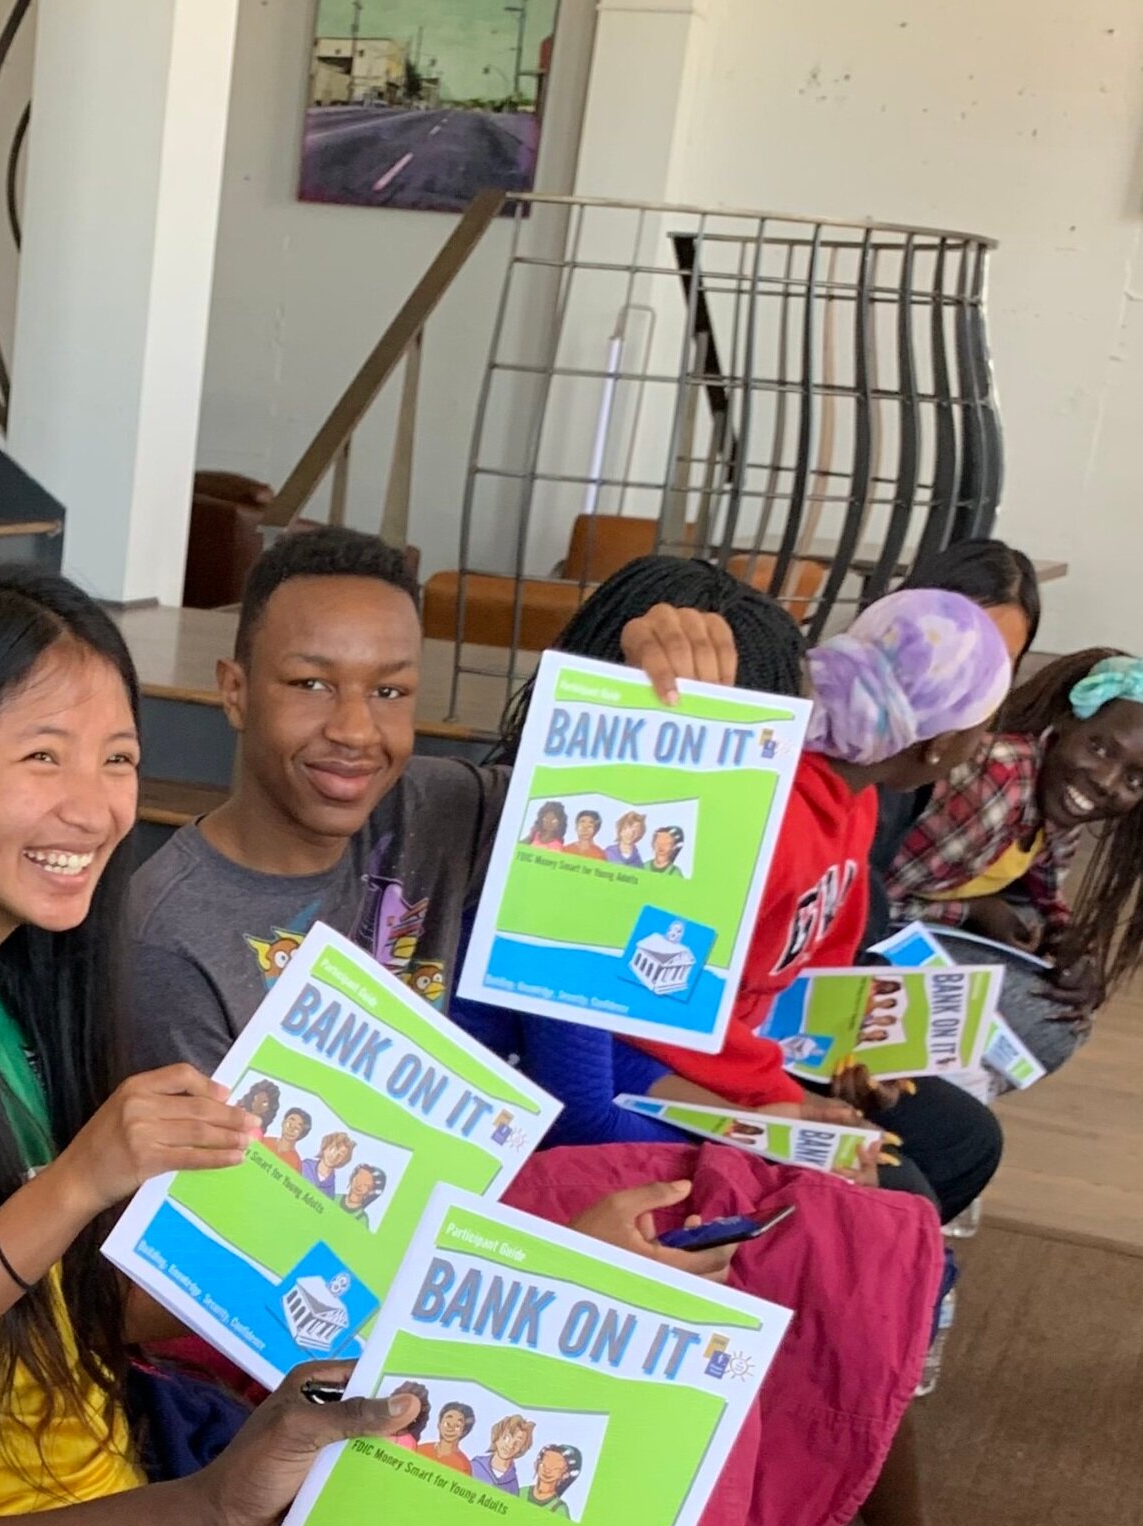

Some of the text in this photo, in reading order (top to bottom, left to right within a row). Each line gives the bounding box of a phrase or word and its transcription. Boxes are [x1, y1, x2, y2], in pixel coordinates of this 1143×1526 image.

[544, 708, 755, 767] BANK ON IT
[930, 973, 965, 1053] BANK ON IT
[280, 981, 494, 1138] BANK ON IT
[445, 1222, 499, 1253] Participant
[410, 1256, 702, 1381] BANK ON IT
[352, 1439, 509, 1516] FDIC Money Smart for Young Adults
